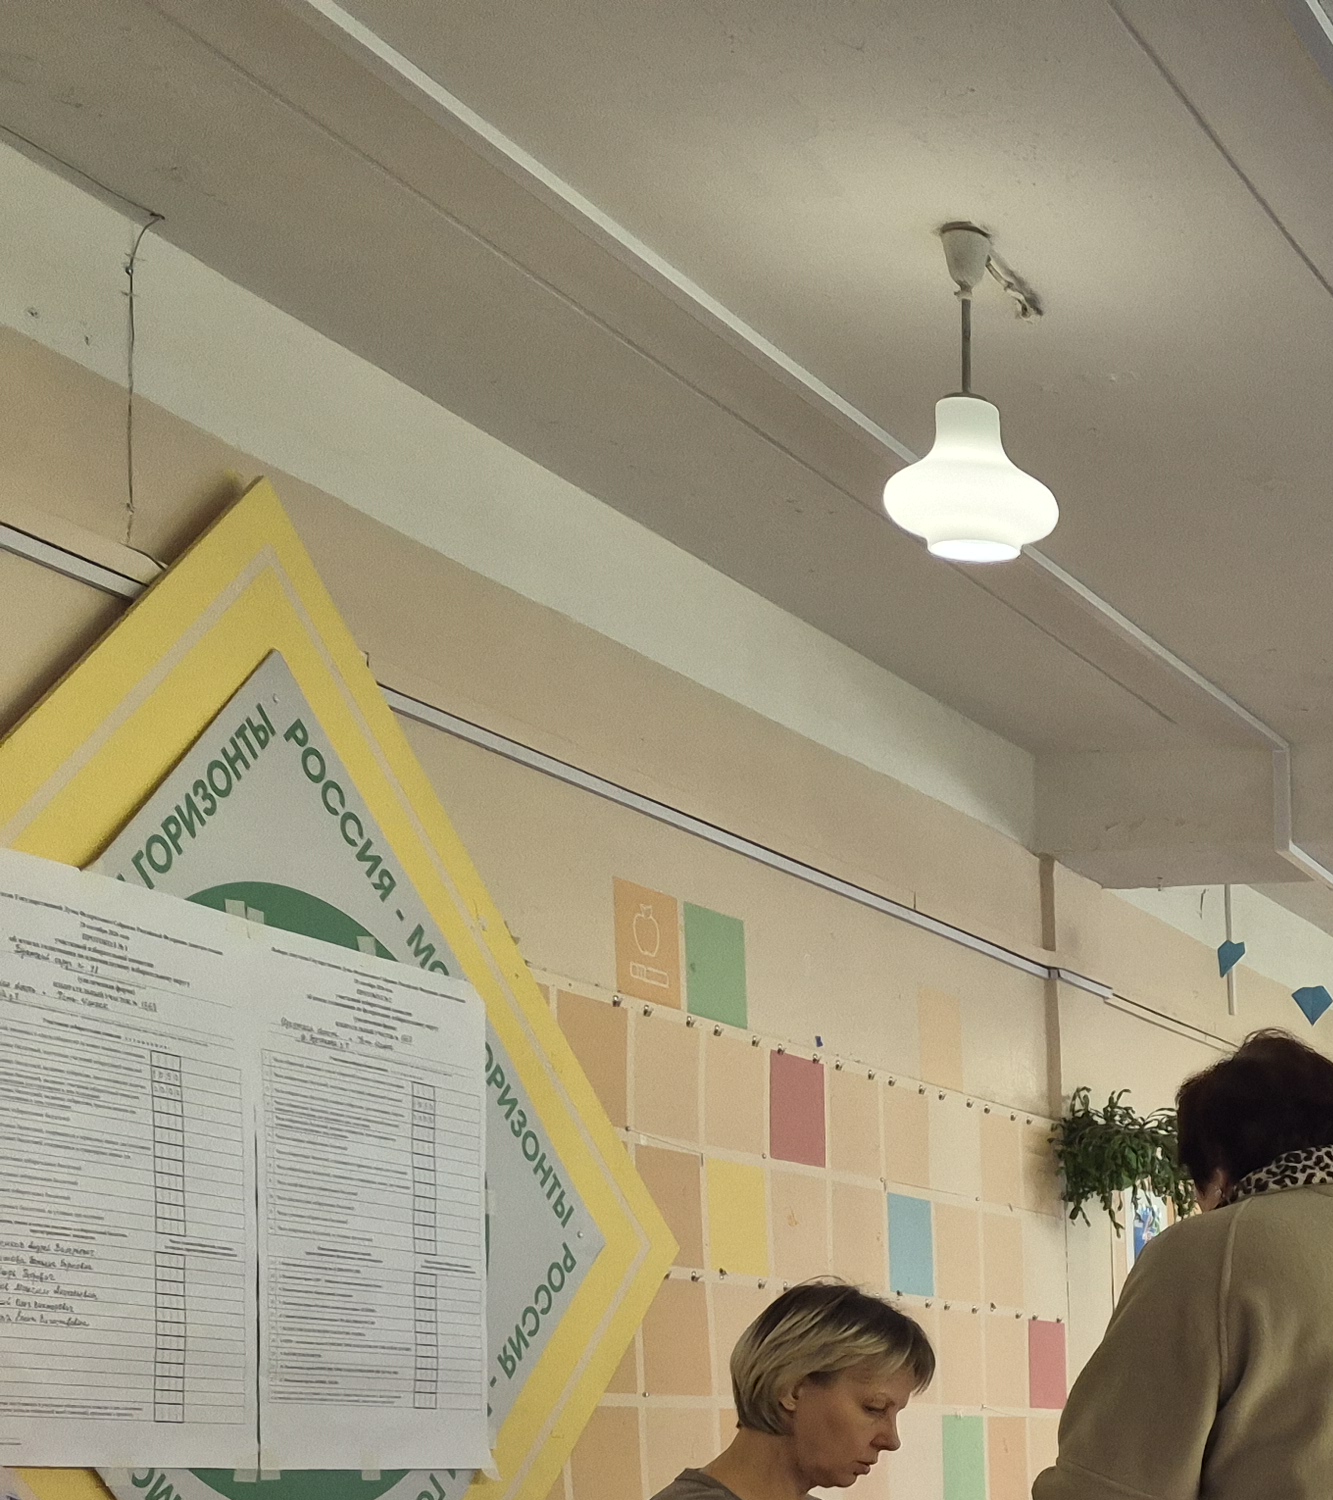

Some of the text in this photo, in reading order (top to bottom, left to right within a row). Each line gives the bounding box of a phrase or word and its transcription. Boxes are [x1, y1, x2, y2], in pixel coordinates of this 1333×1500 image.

[131, 703, 276, 890] ГОРИЗОНТЫ
[283, 718, 397, 902] РОССИЯ
[485, 1041, 575, 1229] РИЗОНТЫ
[497, 1241, 577, 1380] РОССИЯ
